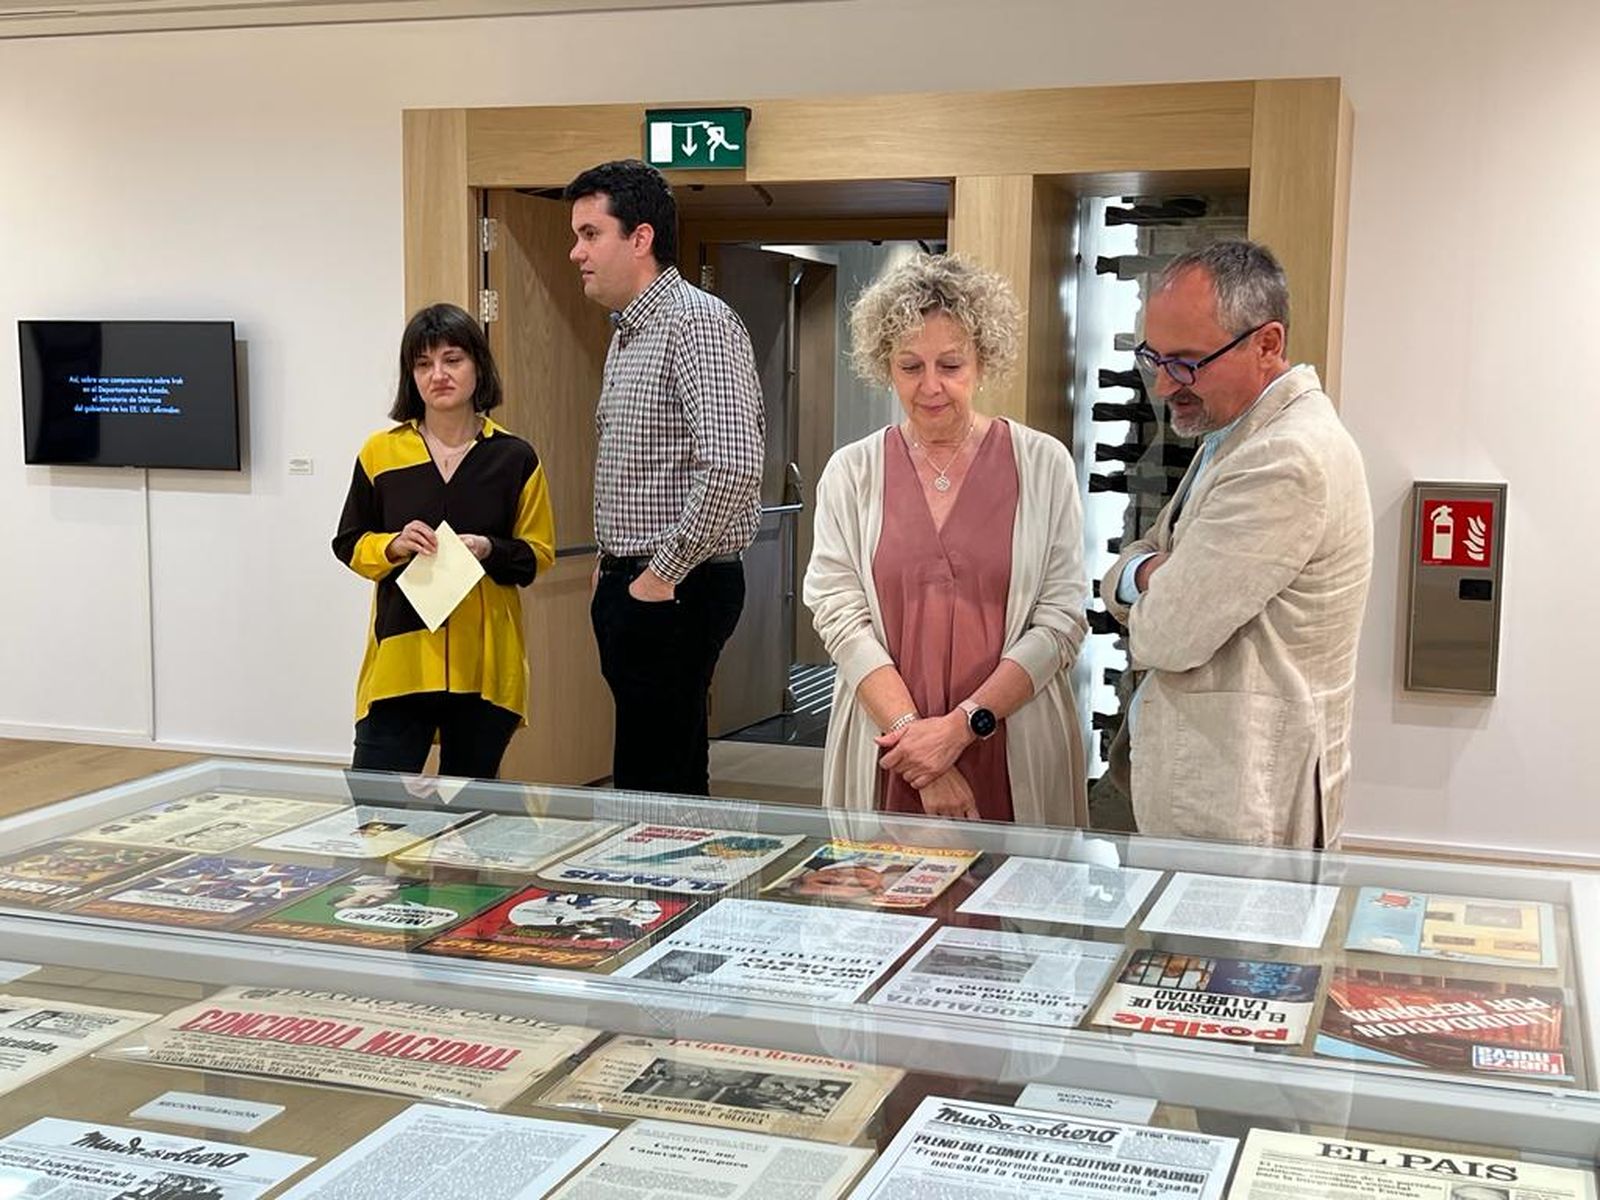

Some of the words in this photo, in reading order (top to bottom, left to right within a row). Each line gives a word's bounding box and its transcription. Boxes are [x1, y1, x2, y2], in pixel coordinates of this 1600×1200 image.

[559, 870, 678, 888] PAPUS
[688, 881, 728, 892] EL
[734, 961, 788, 972] REY
[799, 968, 828, 976] AL
[957, 984, 1015, 994] mano
[1020, 990, 1039, 998] tu
[885, 993, 1034, 1018] SOCIALISTA
[982, 993, 1059, 1008] libertad
[1045, 994, 1072, 1002] en
[1064, 1002, 1089, 1010] La
[1127, 996, 1152, 1010] DE
[1153, 990, 1240, 1008] LIBERTAD
[1243, 998, 1269, 1010] LA
[1482, 997, 1552, 1013] POR
[1046, 1010, 1082, 1023] EL
[1155, 999, 1261, 1021] FANTASMA
[1264, 1011, 1286, 1023] EL
[1340, 1001, 1487, 1023] REFORMA
[1112, 1012, 1288, 1041] posible
[1351, 1011, 1554, 1038] LIQUIDACION
[178, 1009, 364, 1050] CONCORDIA
[355, 1030, 522, 1071] NACIONAL
[695, 1041, 762, 1058] GACETA
[765, 1049, 856, 1071] REGIONAL
[1477, 1046, 1550, 1062] nueva
[281, 1066, 322, 1078] ESPAÑA
[1477, 1058, 1560, 1074] fuerza
[935, 1106, 1013, 1131] Mundo
[1036, 1122, 1120, 1143] obrero
[71, 1130, 145, 1157] Mundo
[692, 1156, 750, 1168] tampoco
[913, 1134, 960, 1149] PLENO
[959, 1141, 984, 1154] DEL
[986, 1144, 1040, 1162] COMITE
[1041, 1153, 1121, 1172] EJECUTIVO
[1122, 1162, 1143, 1176] EN
[1142, 1167, 1206, 1184] MADRID
[1317, 1142, 1387, 1165] EL
[1397, 1152, 1519, 1182] PAIS
[40, 1159, 101, 1174] bandera
[101, 1170, 121, 1178] es
[930, 1159, 990, 1174] necesita
[994, 1167, 1008, 1176] la
[1012, 1170, 1064, 1185] ruptura
[963, 1153, 978, 1163] al
[979, 1157, 1060, 1175] reformismo
[1064, 1168, 1142, 1185] continuista
[1147, 1179, 1199, 1194] España
